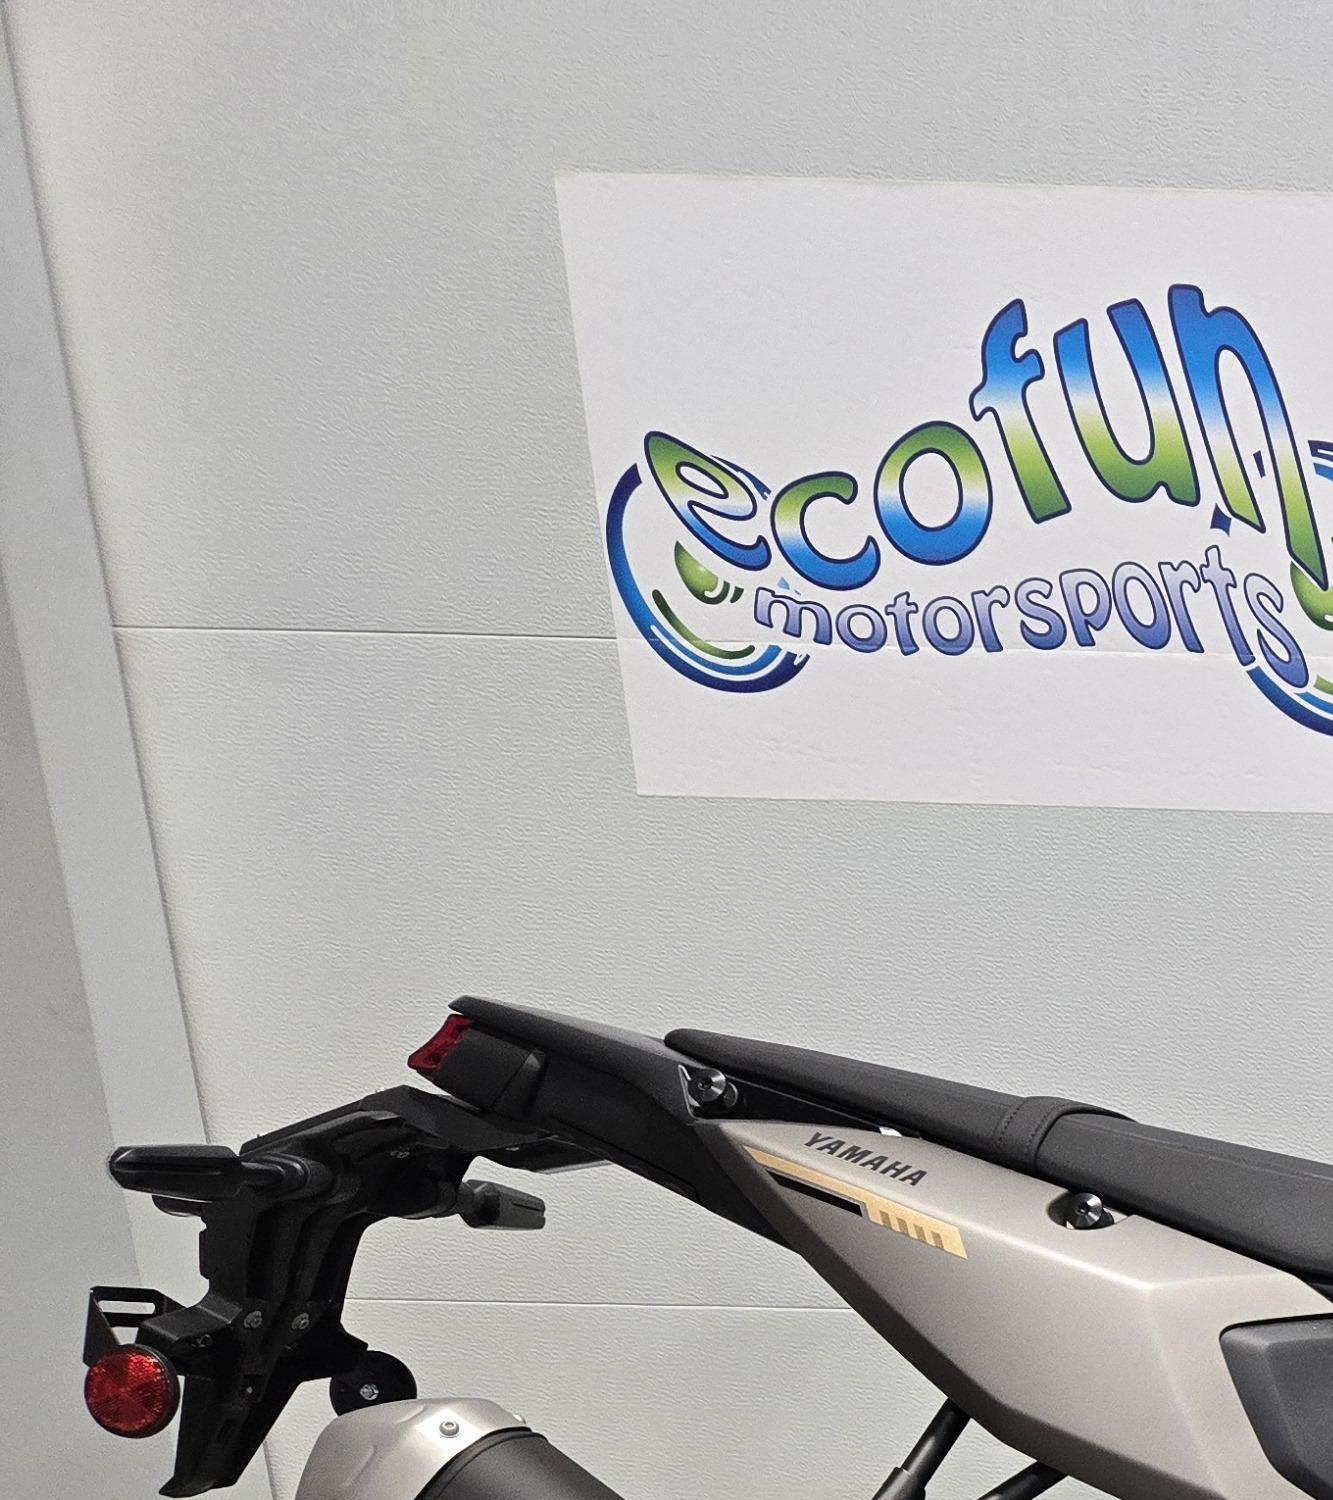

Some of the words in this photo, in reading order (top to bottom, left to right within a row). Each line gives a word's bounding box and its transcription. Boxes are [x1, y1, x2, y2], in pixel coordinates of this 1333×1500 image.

[645, 284, 1328, 590] ecofun
[754, 545, 1310, 690] motorsports
[804, 1131, 928, 1187] YAMAHA
